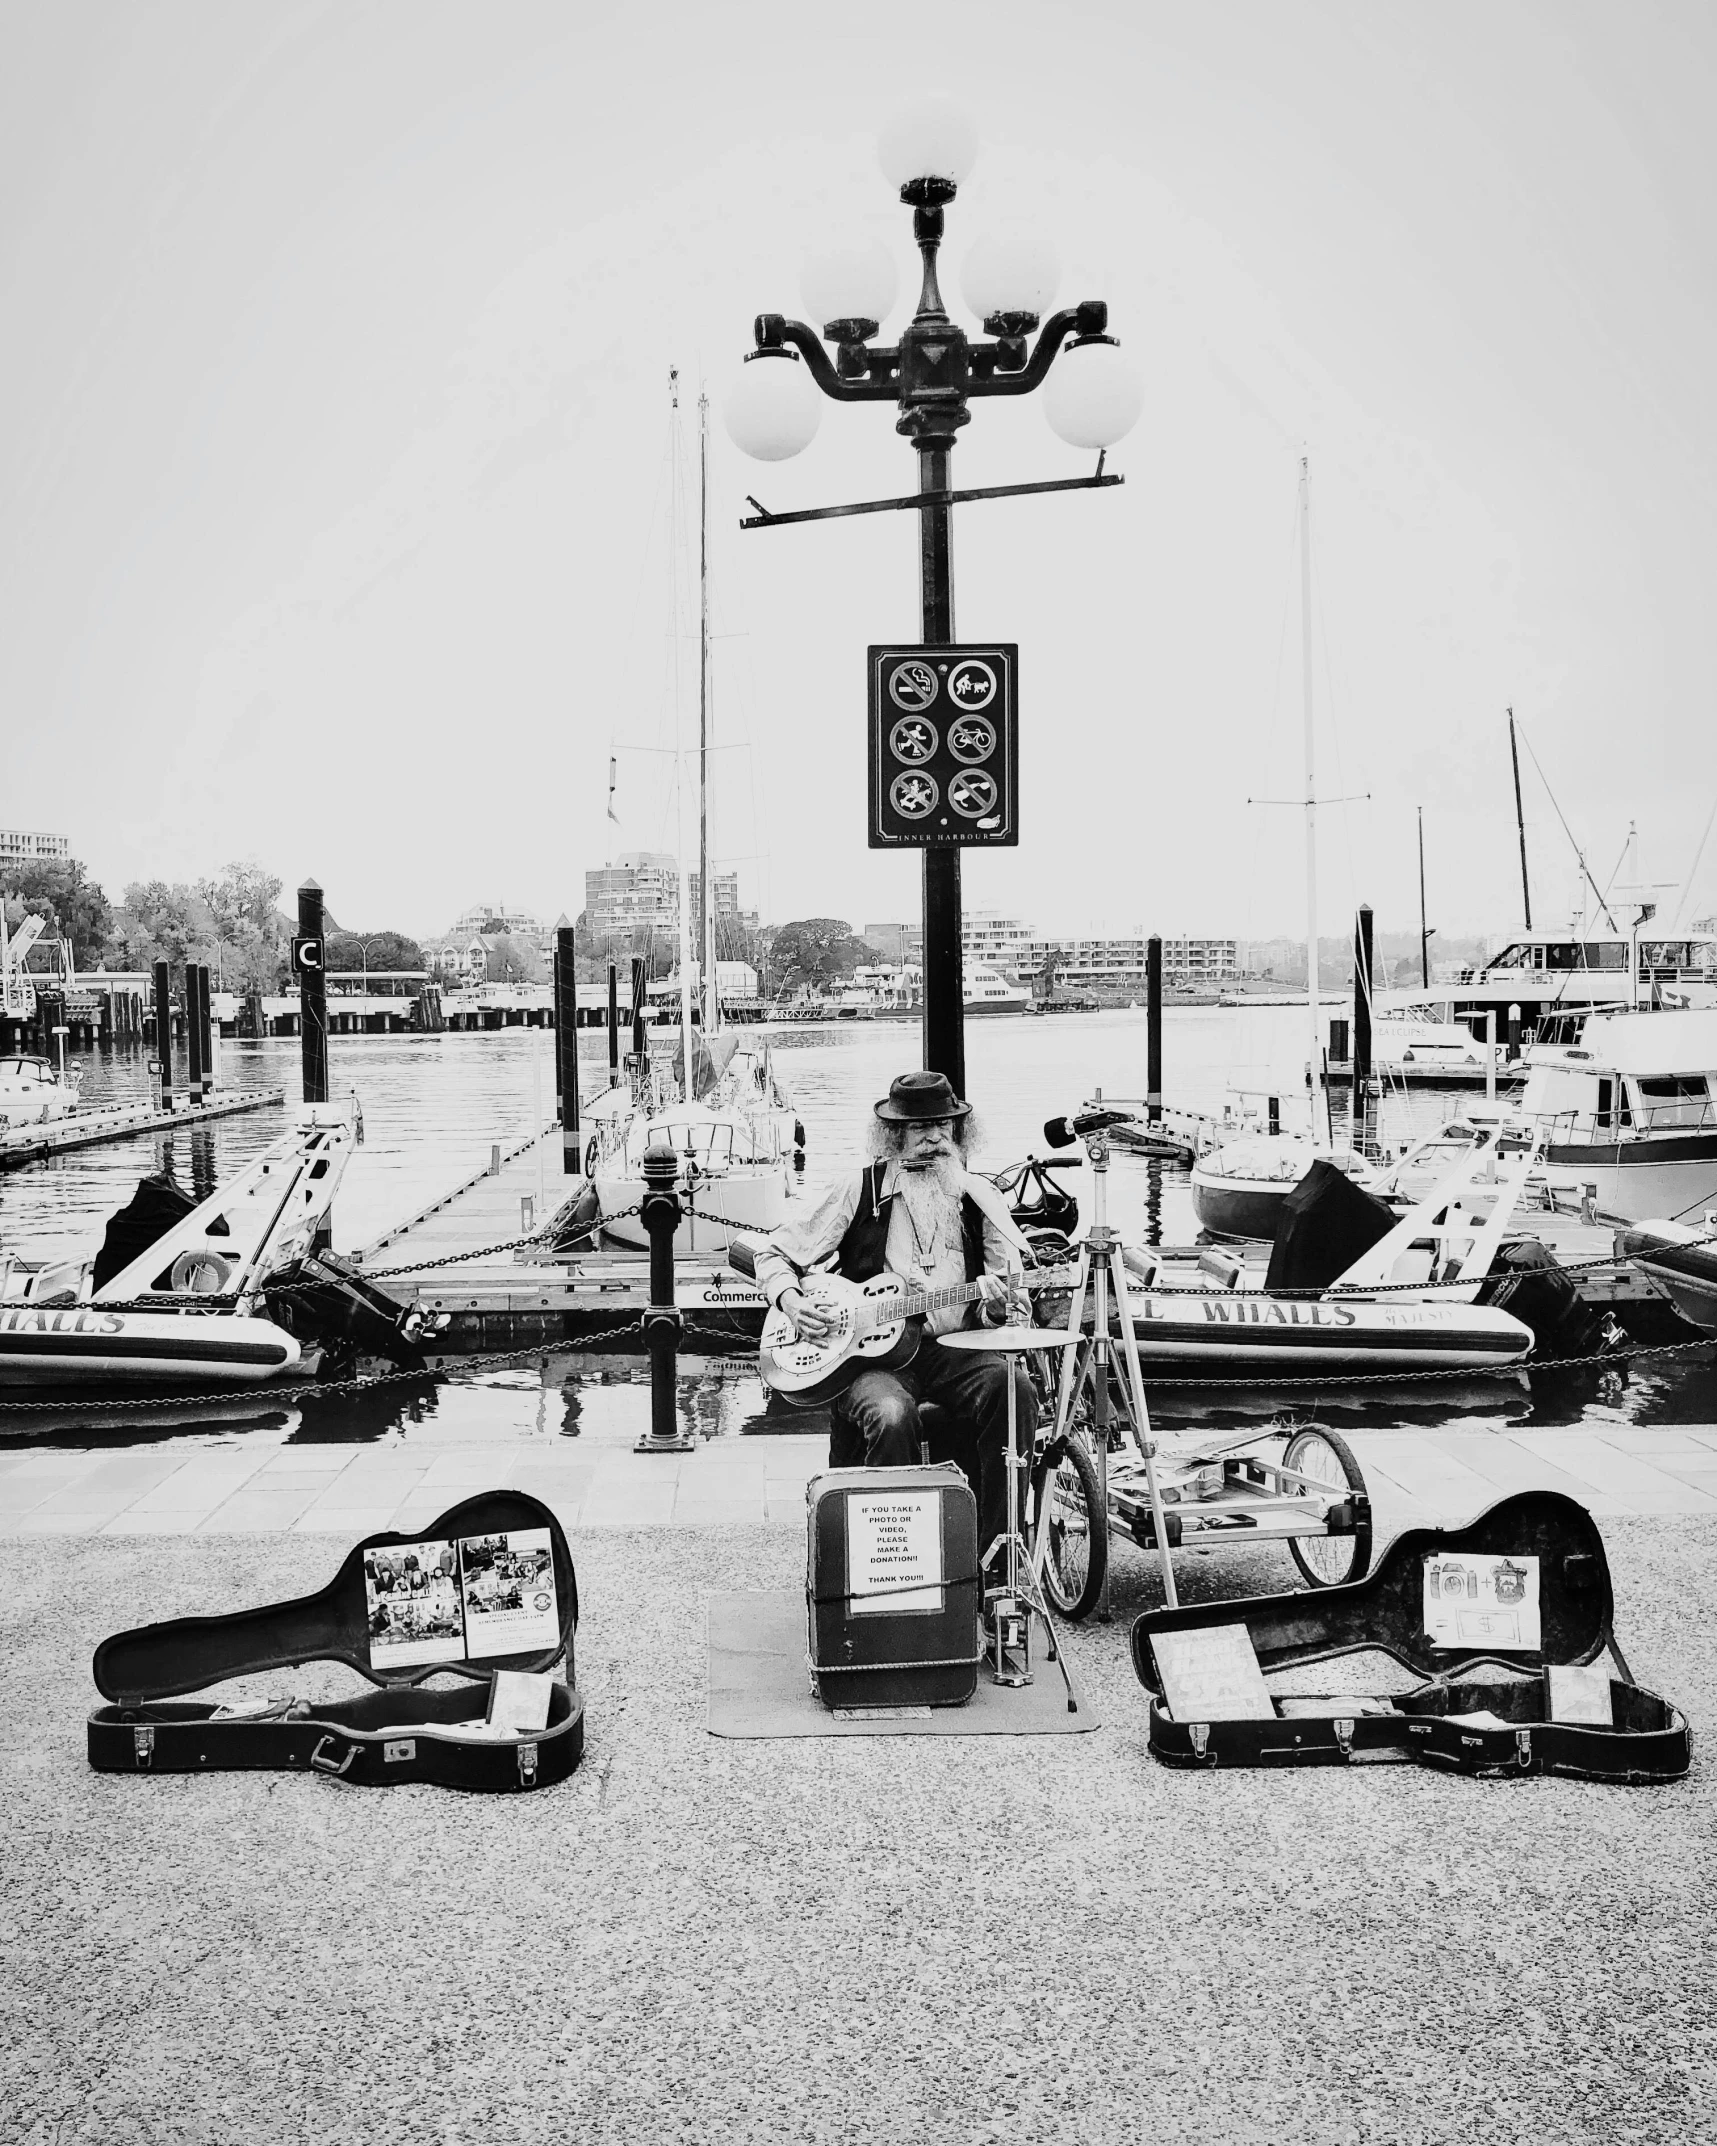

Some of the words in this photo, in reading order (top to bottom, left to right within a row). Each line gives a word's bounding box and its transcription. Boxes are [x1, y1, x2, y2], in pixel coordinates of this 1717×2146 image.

[899, 834, 932, 842] INNER
[937, 833, 989, 841] HARBOUR
[299, 942, 318, 966] C
[1202, 1302, 1356, 1326] WHALES
[1384, 1310, 1453, 1326] MAJESTY
[869, 1516, 898, 1524] PHOTO
[878, 1526, 907, 1534] VIDEO,
[870, 1555, 918, 1564] DONATION!!
[868, 1575, 897, 1583] THANK
